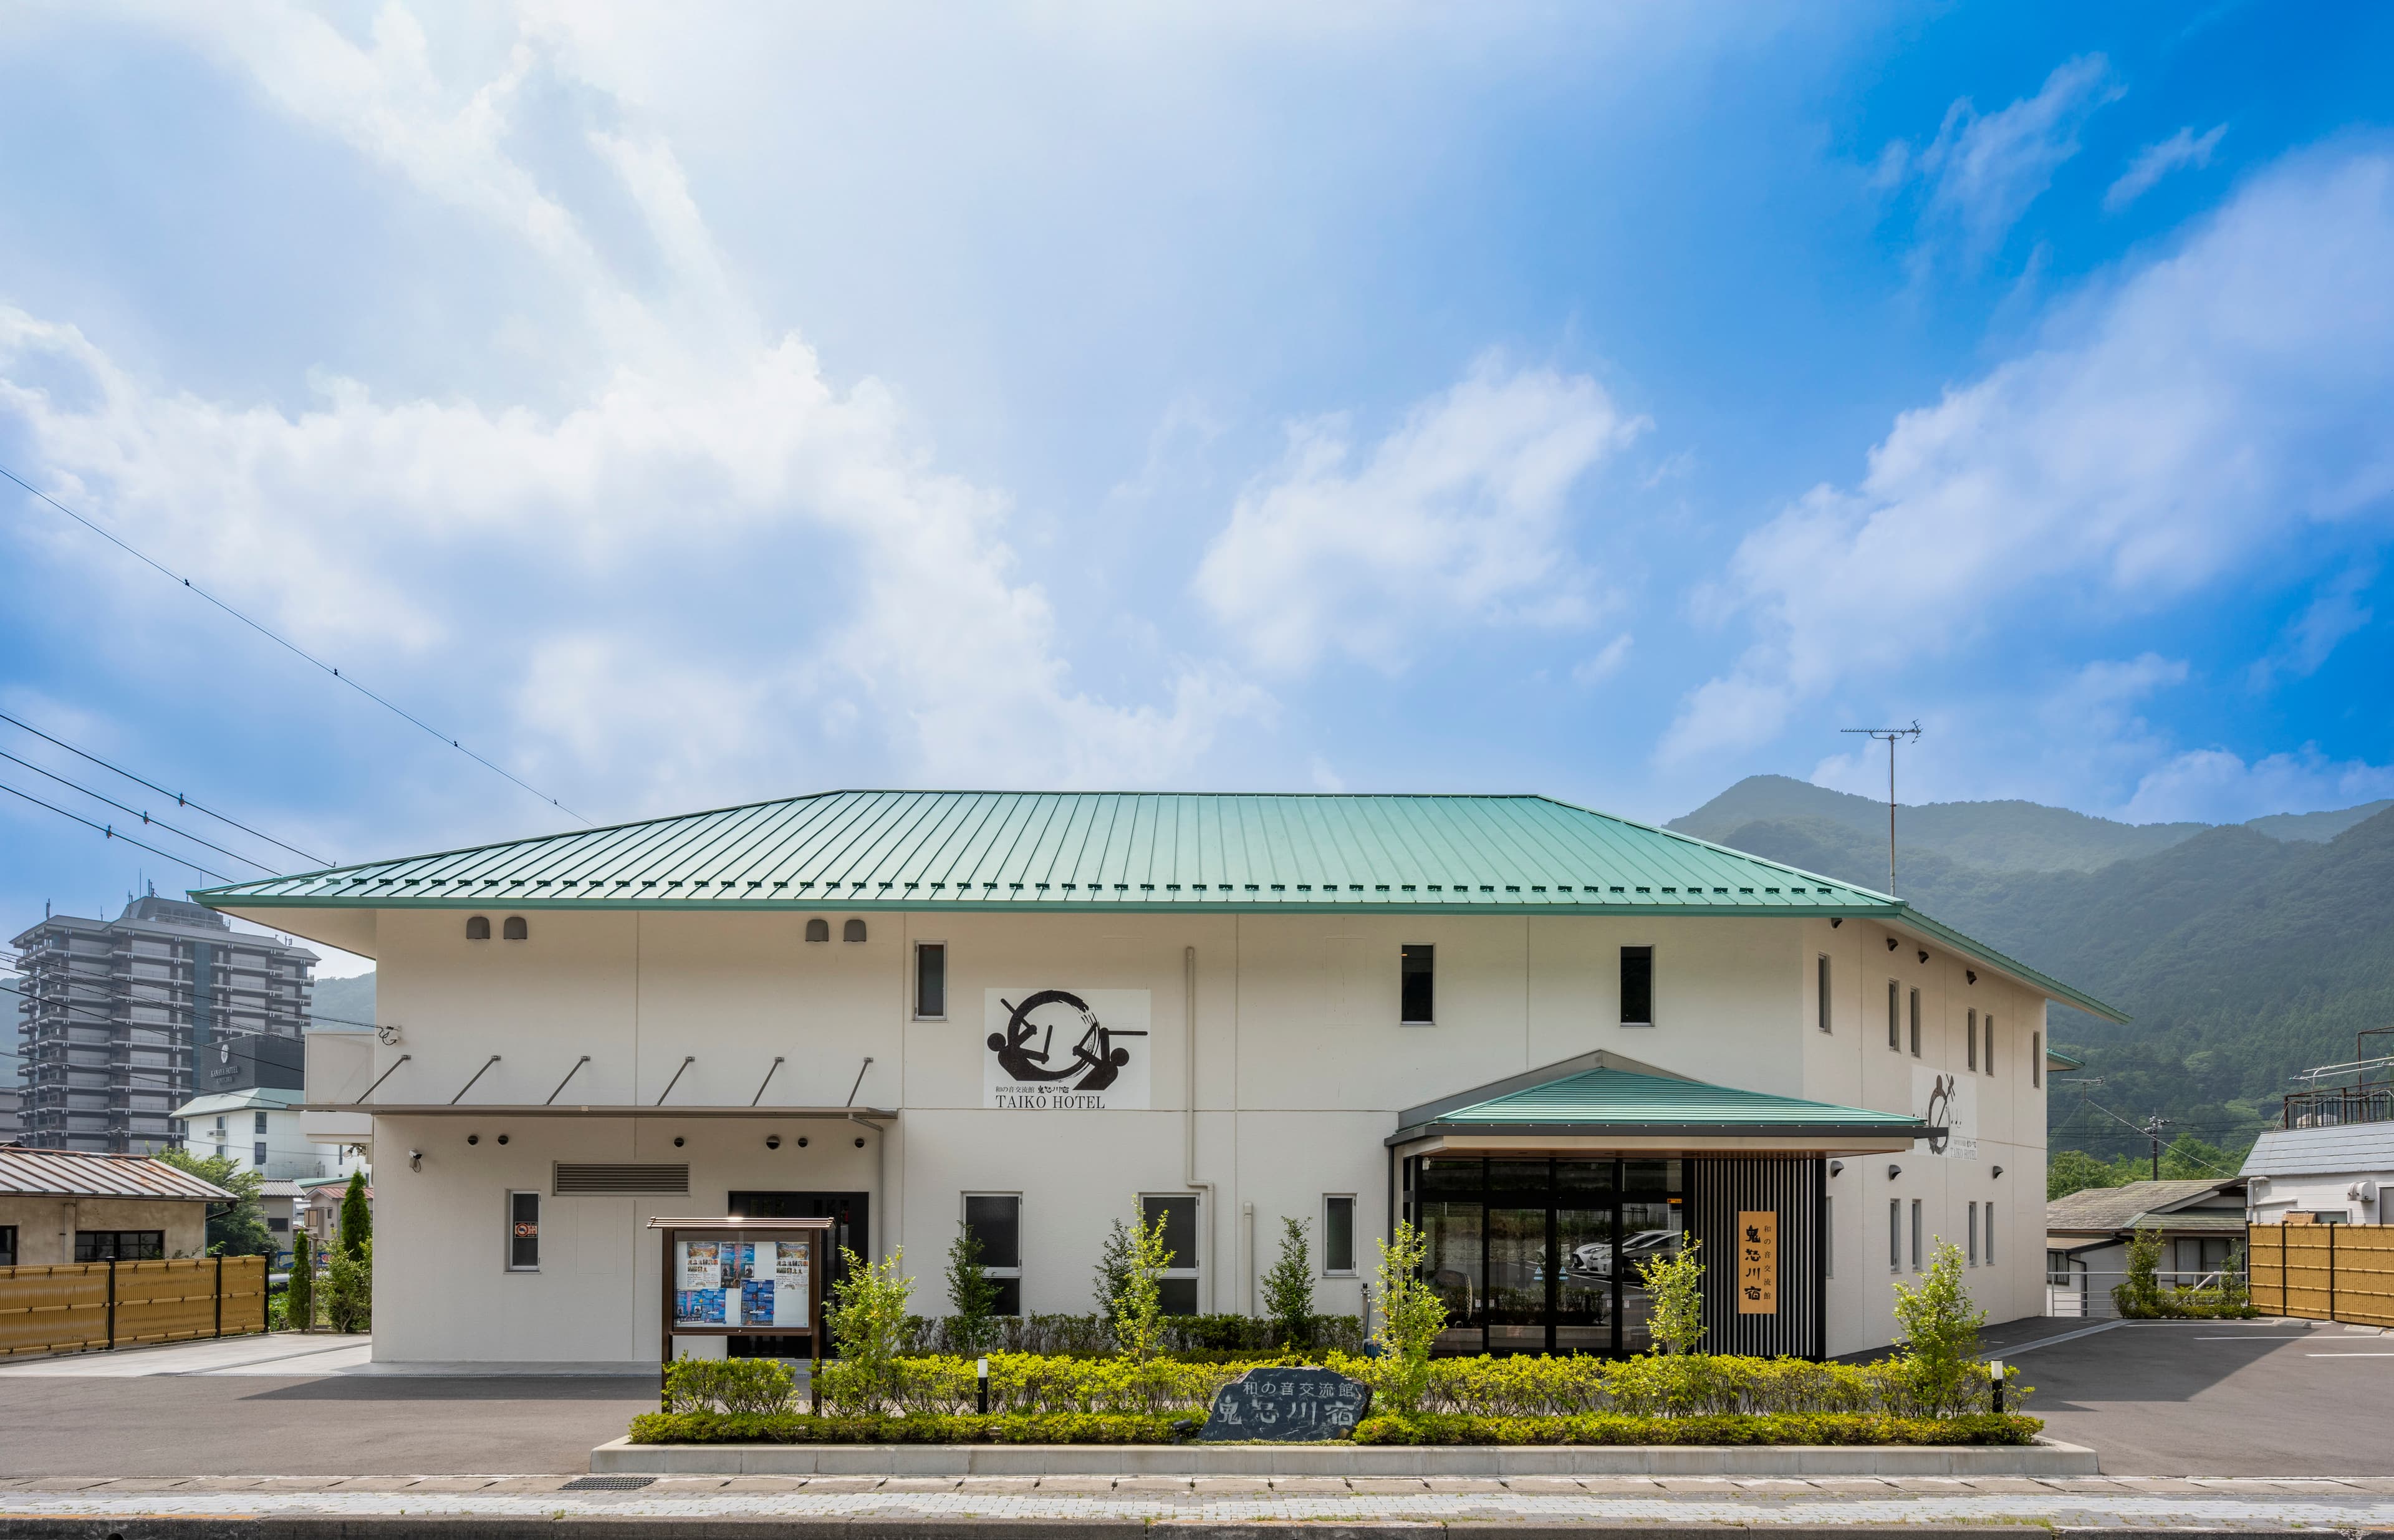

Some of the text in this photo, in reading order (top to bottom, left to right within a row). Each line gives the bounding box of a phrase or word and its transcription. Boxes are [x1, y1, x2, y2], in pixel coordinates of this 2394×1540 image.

[225, 1066, 238, 1075] HOTEL
[996, 1085, 1035, 1094] 和の音交流館
[996, 1095, 1105, 1109] TAIKO HOTEL
[1744, 1225, 1761, 1301] 鬼怒川宿
[1763, 1225, 1771, 1300] 和の音交流館
[1243, 1381, 1355, 1397] 和の音交流館
[1216, 1394, 1355, 1427] 鬼怒川宿
